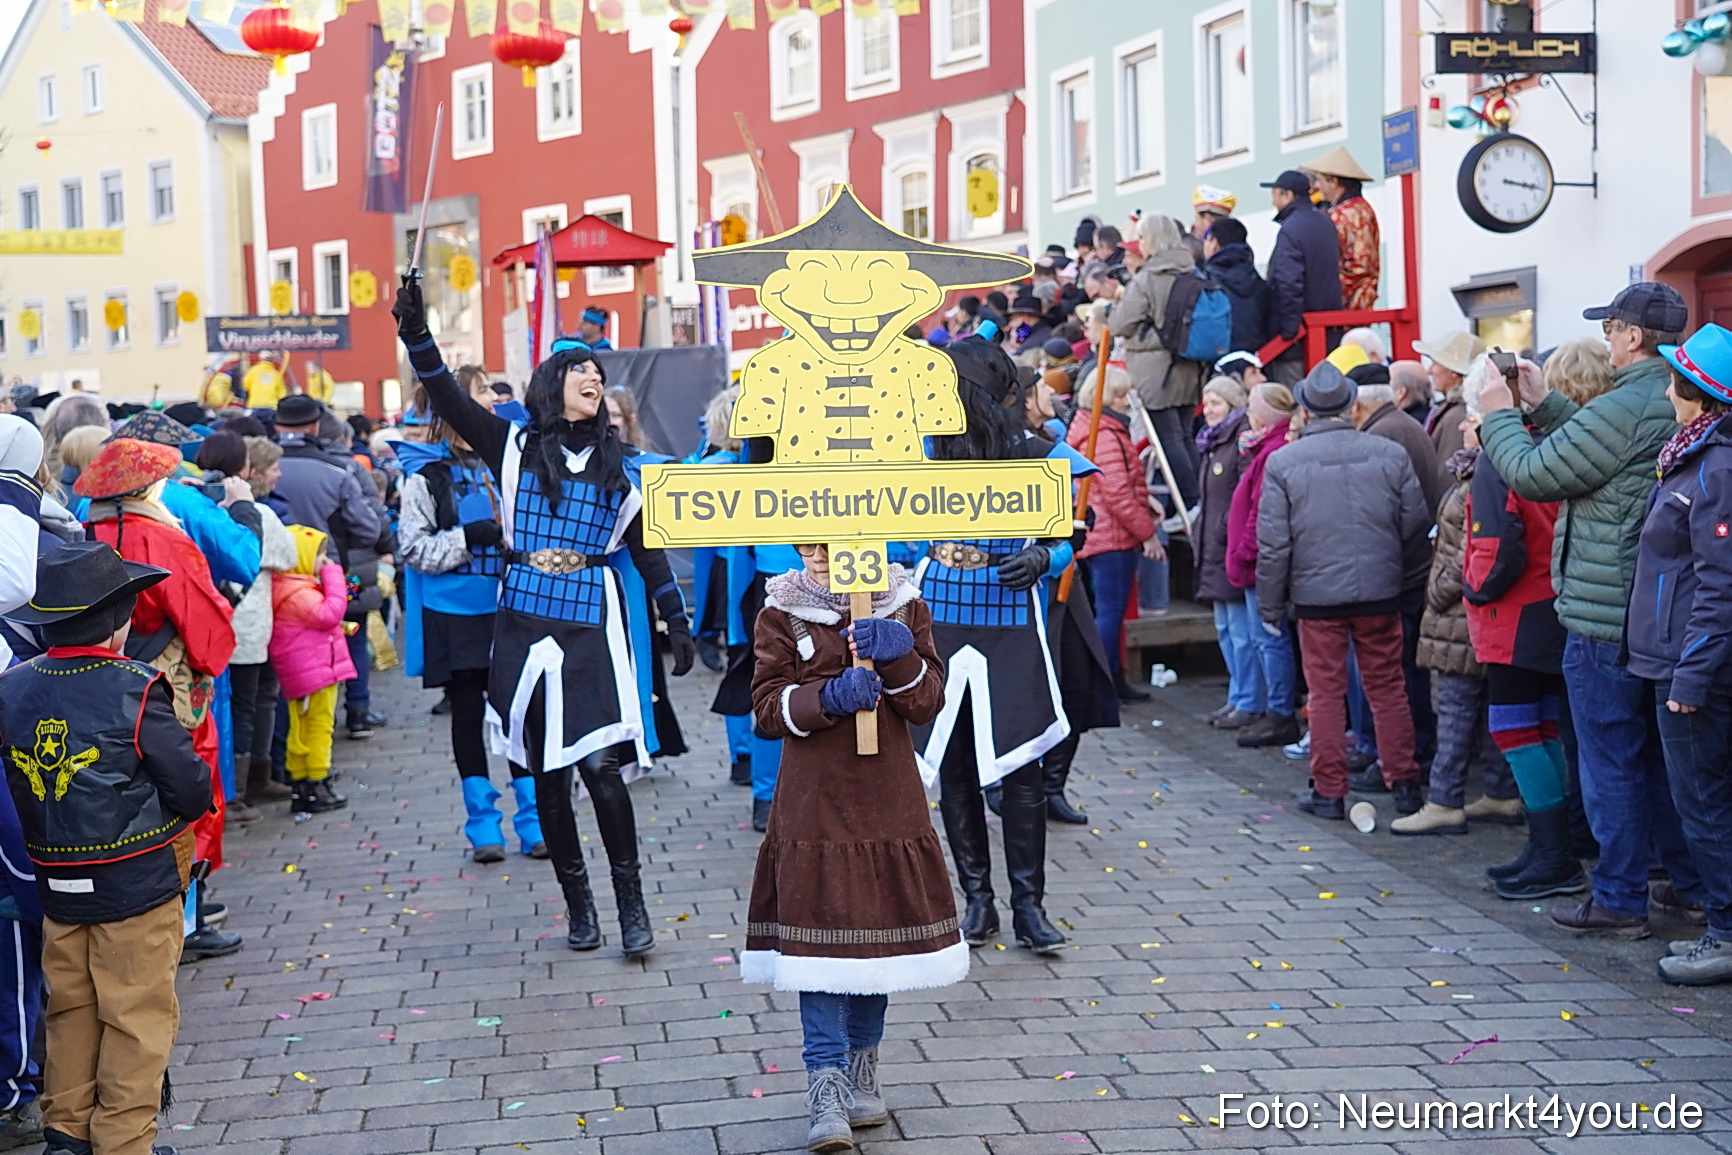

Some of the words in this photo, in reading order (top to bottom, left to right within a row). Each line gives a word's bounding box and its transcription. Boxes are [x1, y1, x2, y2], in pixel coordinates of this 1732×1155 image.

[1450, 36, 1580, 57] RÖHLICH
[217, 329, 340, 350] Virusschleuder
[666, 489, 741, 520] TSV
[755, 484, 1042, 521] Dietfurt/Volleyball
[834, 550, 883, 585] 33
